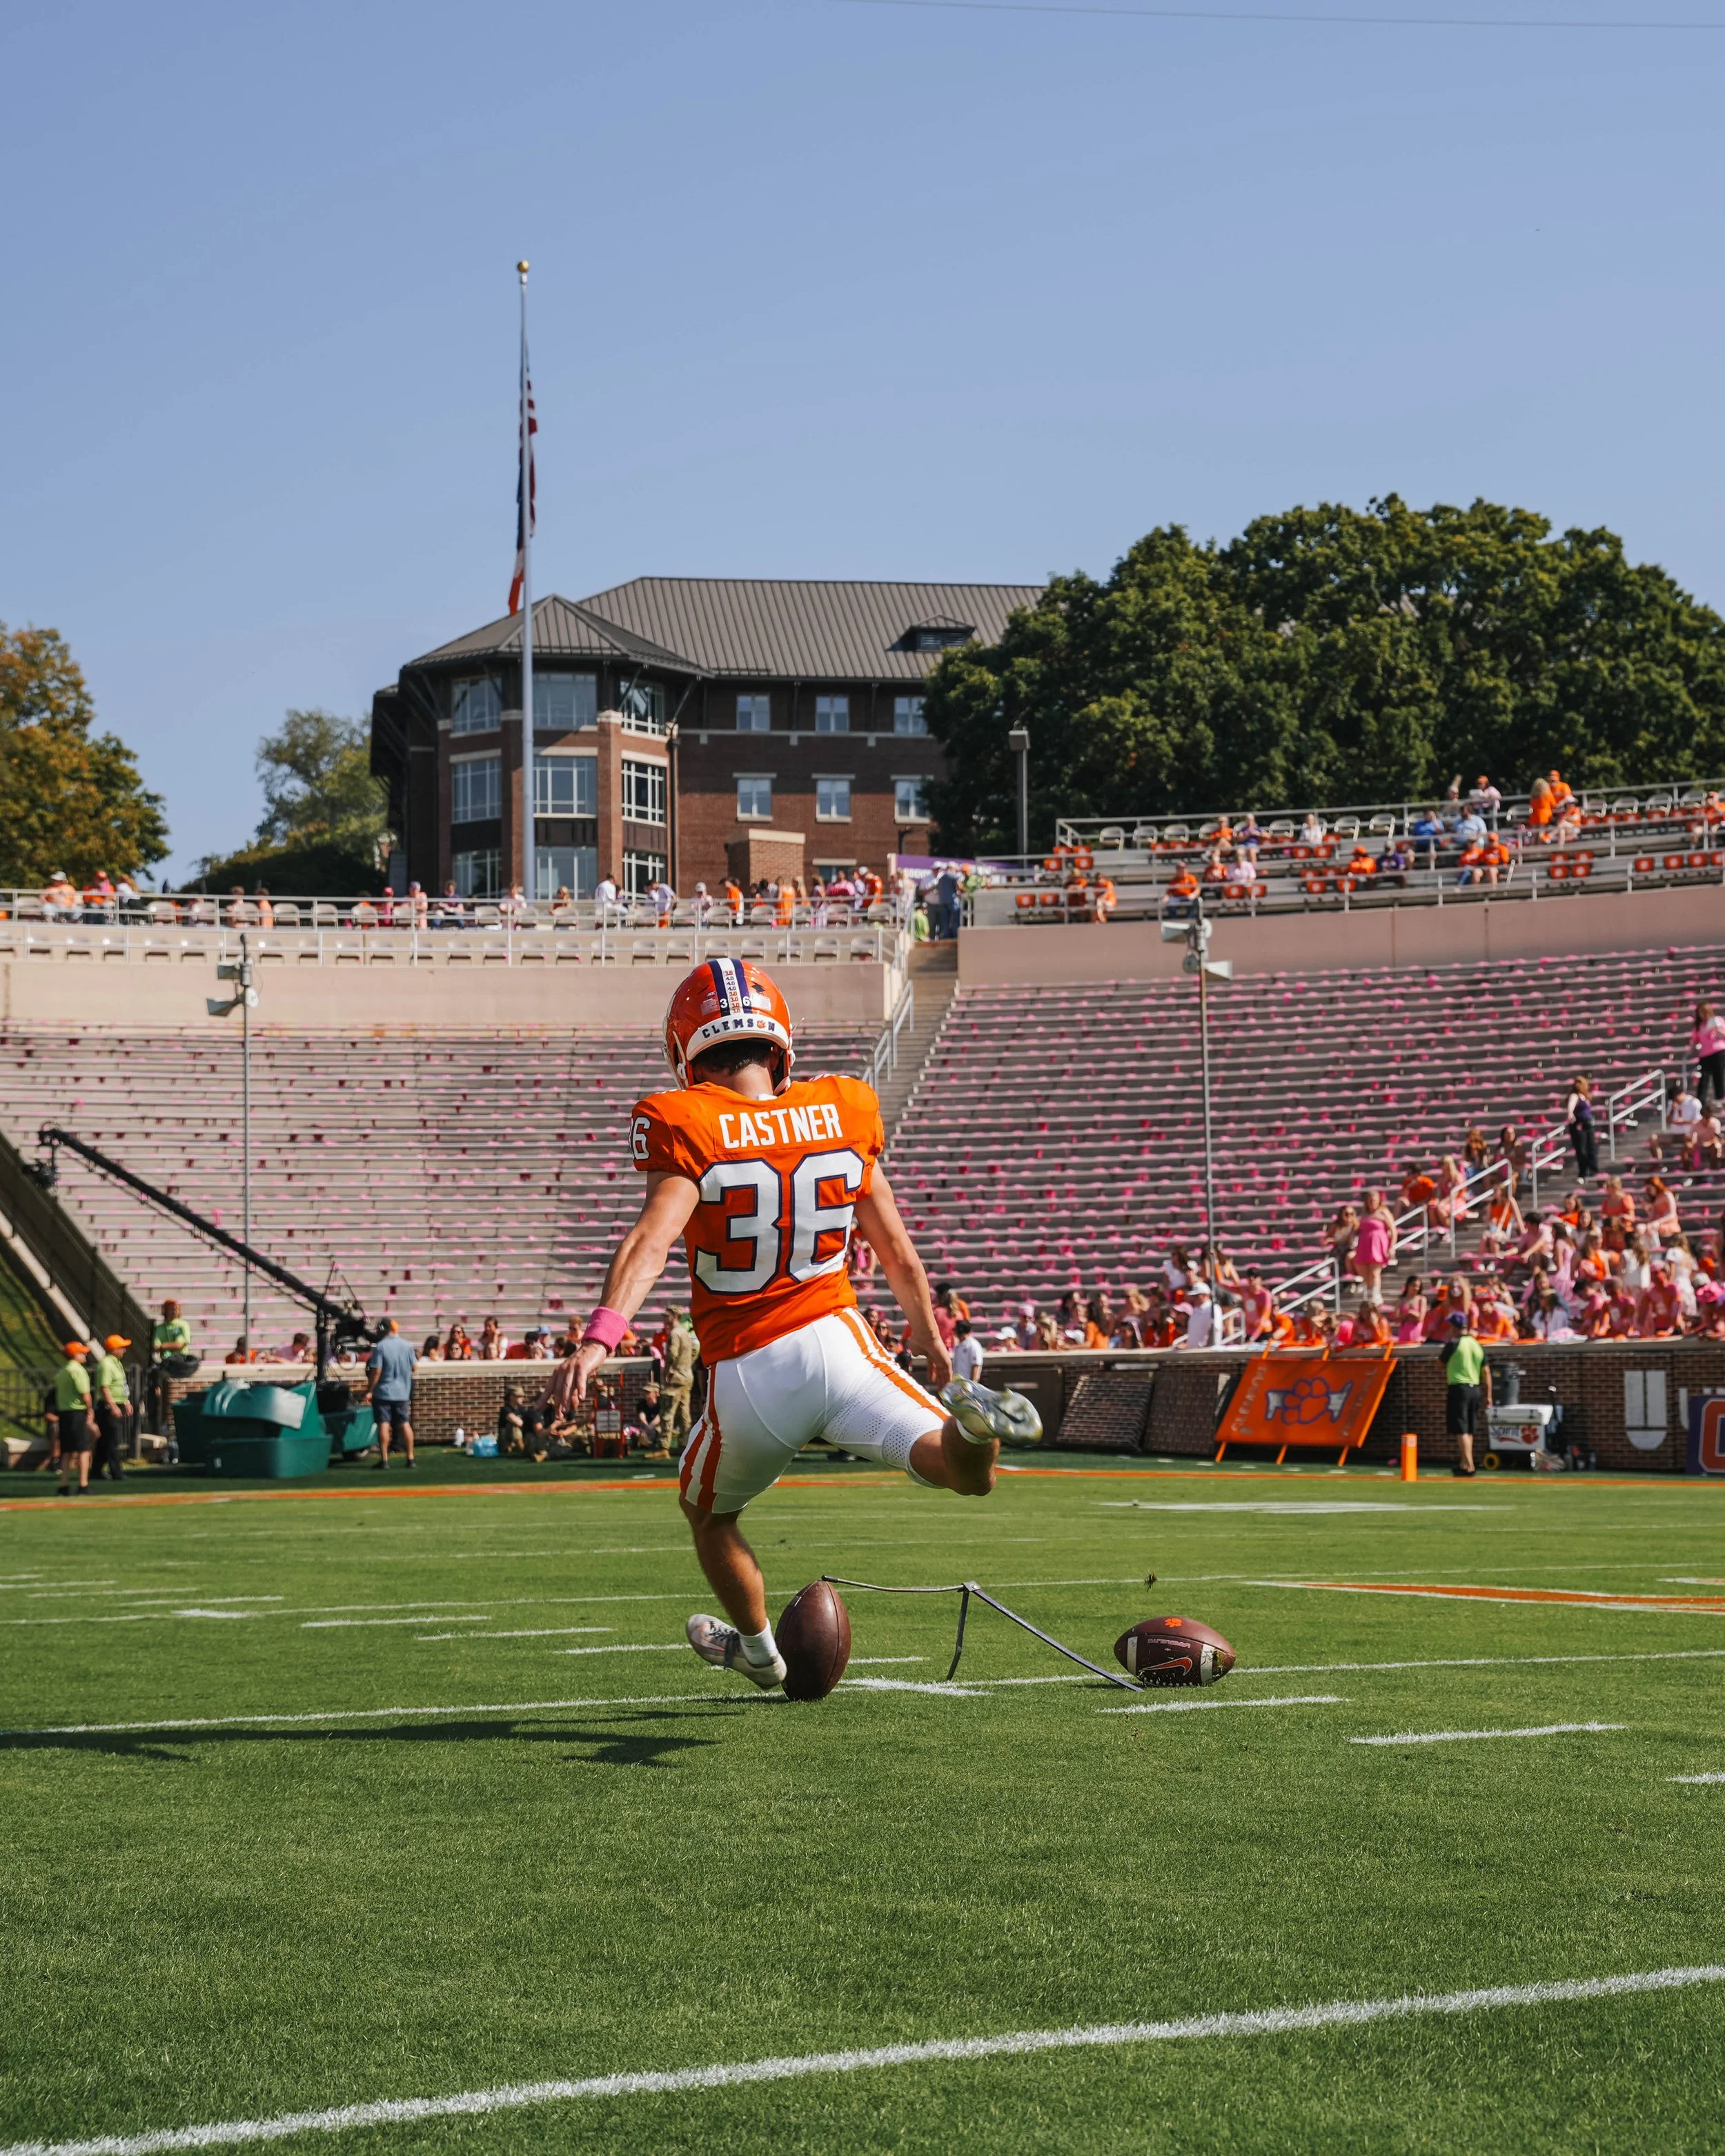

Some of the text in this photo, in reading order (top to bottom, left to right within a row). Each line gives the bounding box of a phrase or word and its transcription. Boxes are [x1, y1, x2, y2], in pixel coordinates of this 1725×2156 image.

[720, 998, 728, 1009] 3
[742, 996, 751, 1007] 6
[702, 1018, 776, 1039] CLEMSN
[629, 1116, 651, 1161] 6
[718, 1103, 843, 1149] CASTNER
[693, 1147, 865, 1296] 36
